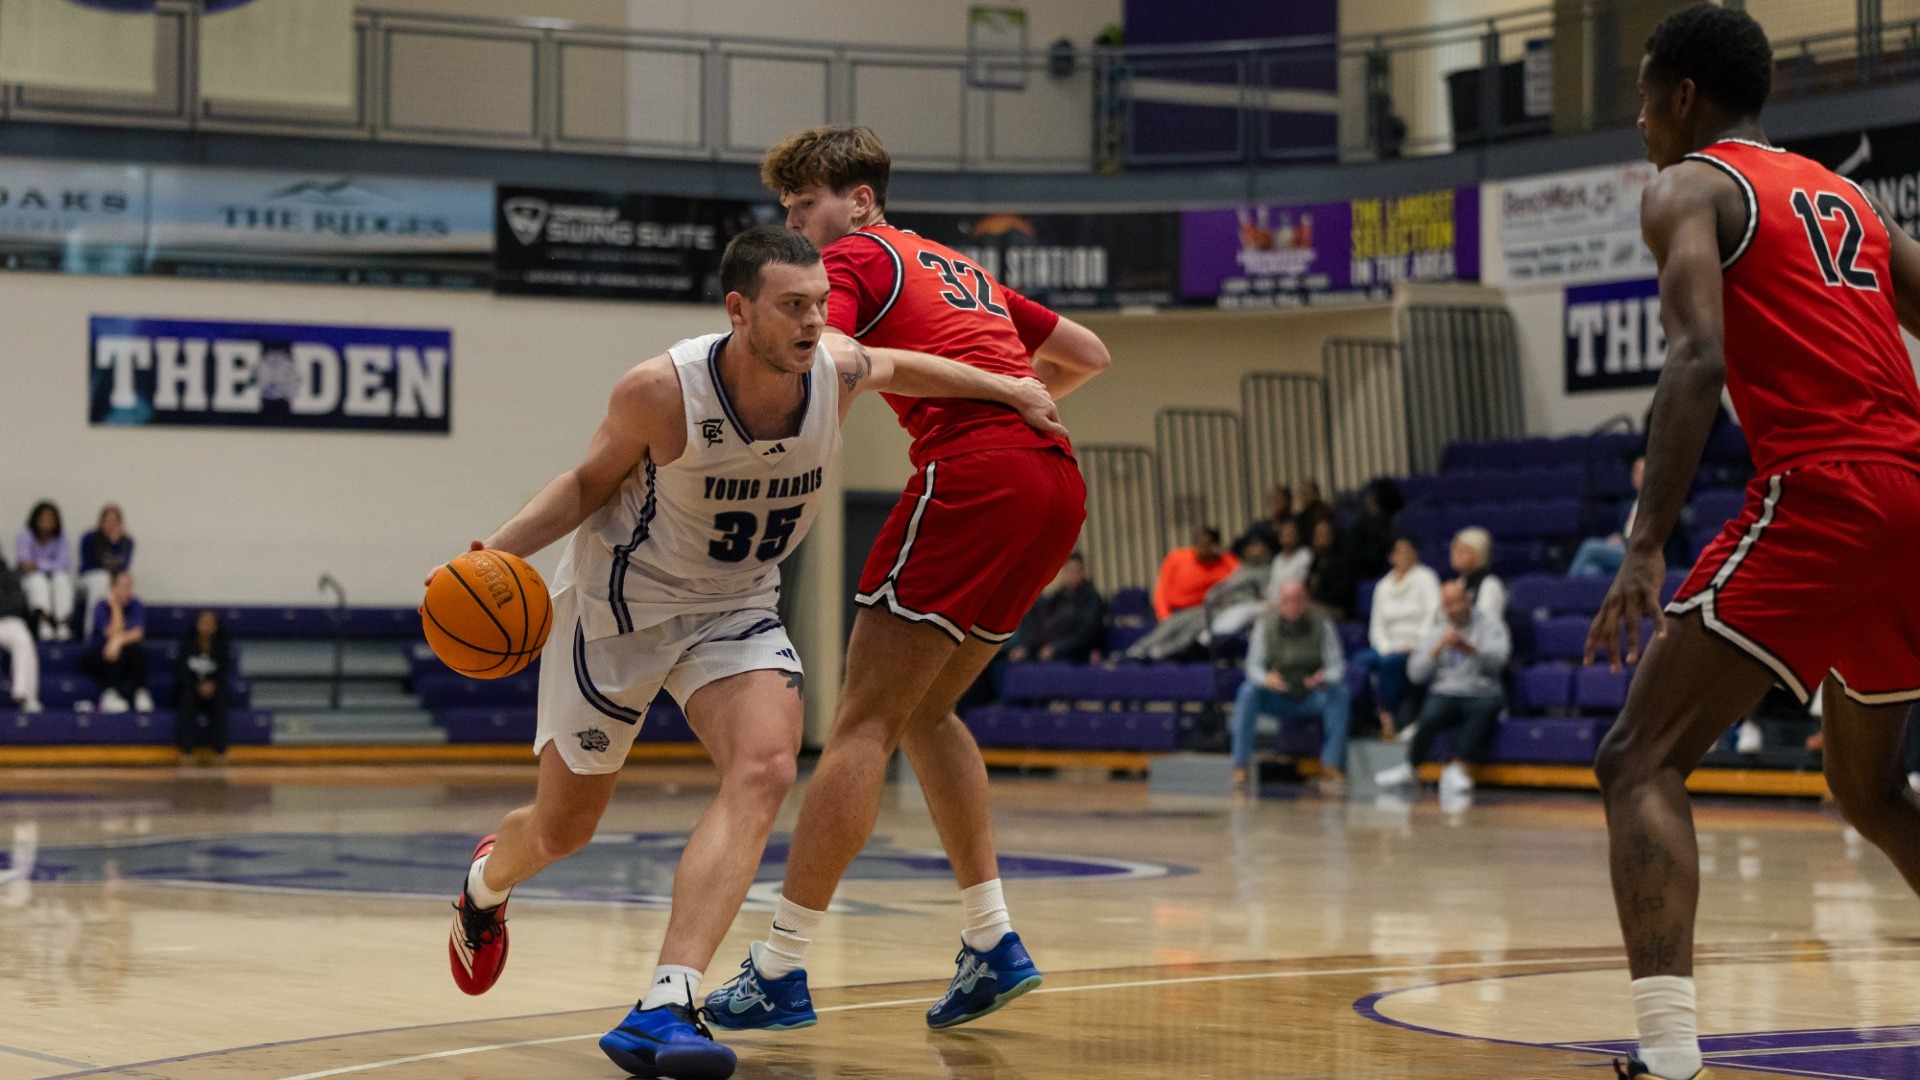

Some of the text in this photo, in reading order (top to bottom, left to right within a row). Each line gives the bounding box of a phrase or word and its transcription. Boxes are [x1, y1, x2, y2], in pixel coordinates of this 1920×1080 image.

[546, 220, 716, 250] SWING SUITE
[1351, 222, 1453, 259] SELECTION
[1790, 188, 1880, 291] 12
[917, 249, 1011, 322] 32
[1005, 246, 1108, 289] STATION
[1568, 297, 1668, 376] THE
[95, 336, 447, 418] THE DEN
[704, 467, 823, 501] YOUNG HARRIS
[707, 502, 806, 563] 35
